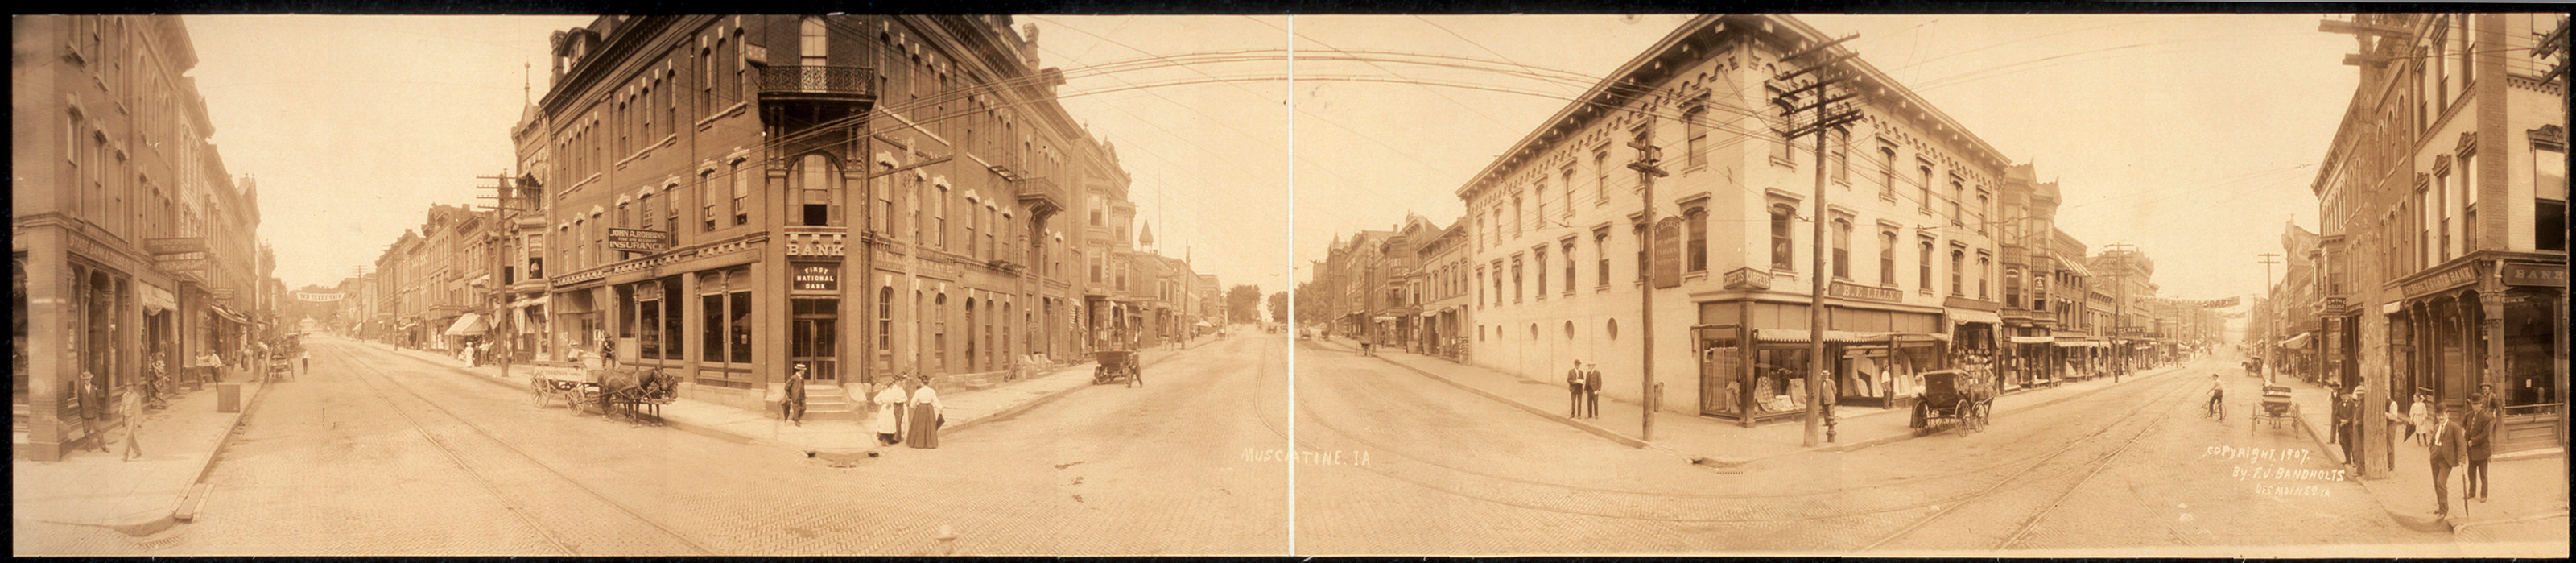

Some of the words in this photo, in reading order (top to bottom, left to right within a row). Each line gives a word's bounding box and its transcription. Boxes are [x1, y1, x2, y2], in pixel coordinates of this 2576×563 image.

[609, 230, 629, 238] JOHN
[69, 234, 89, 253] STATE
[89, 243, 105, 259] BANK
[609, 241, 666, 250] INSURANCE
[786, 244, 844, 256] BANK
[804, 266, 829, 275] FIRST
[2515, 269, 2564, 279] BANK
[2429, 275, 2449, 289] STATE
[2450, 267, 2471, 283] BANK
[2202, 300, 2227, 308] SOAP
